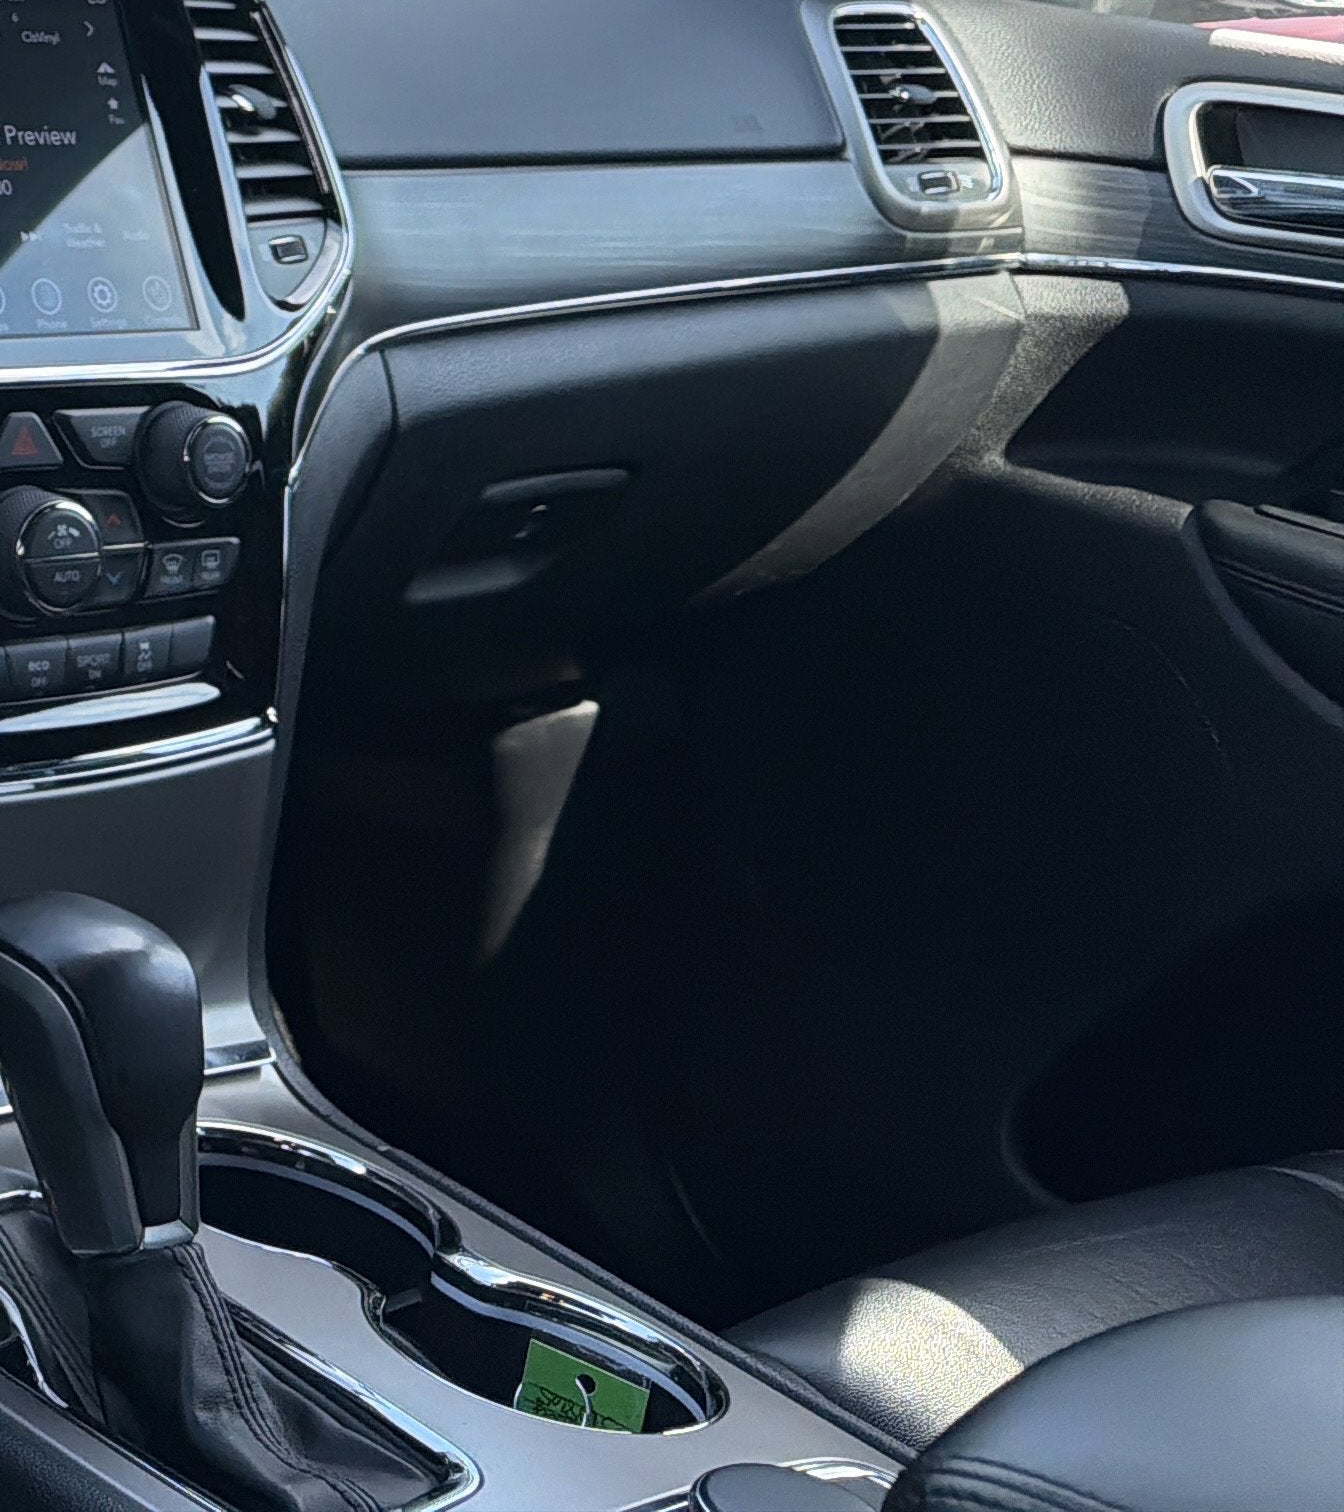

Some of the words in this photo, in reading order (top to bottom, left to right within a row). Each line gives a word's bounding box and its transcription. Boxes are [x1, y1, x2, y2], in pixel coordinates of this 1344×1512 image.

[3, 126, 77, 145] Preview
[91, 425, 127, 439] SCREEN
[53, 535, 73, 550] OFF
[53, 569, 80, 583] AUTO
[28, 660, 50, 671] eco
[77, 653, 110, 667] SPORT
